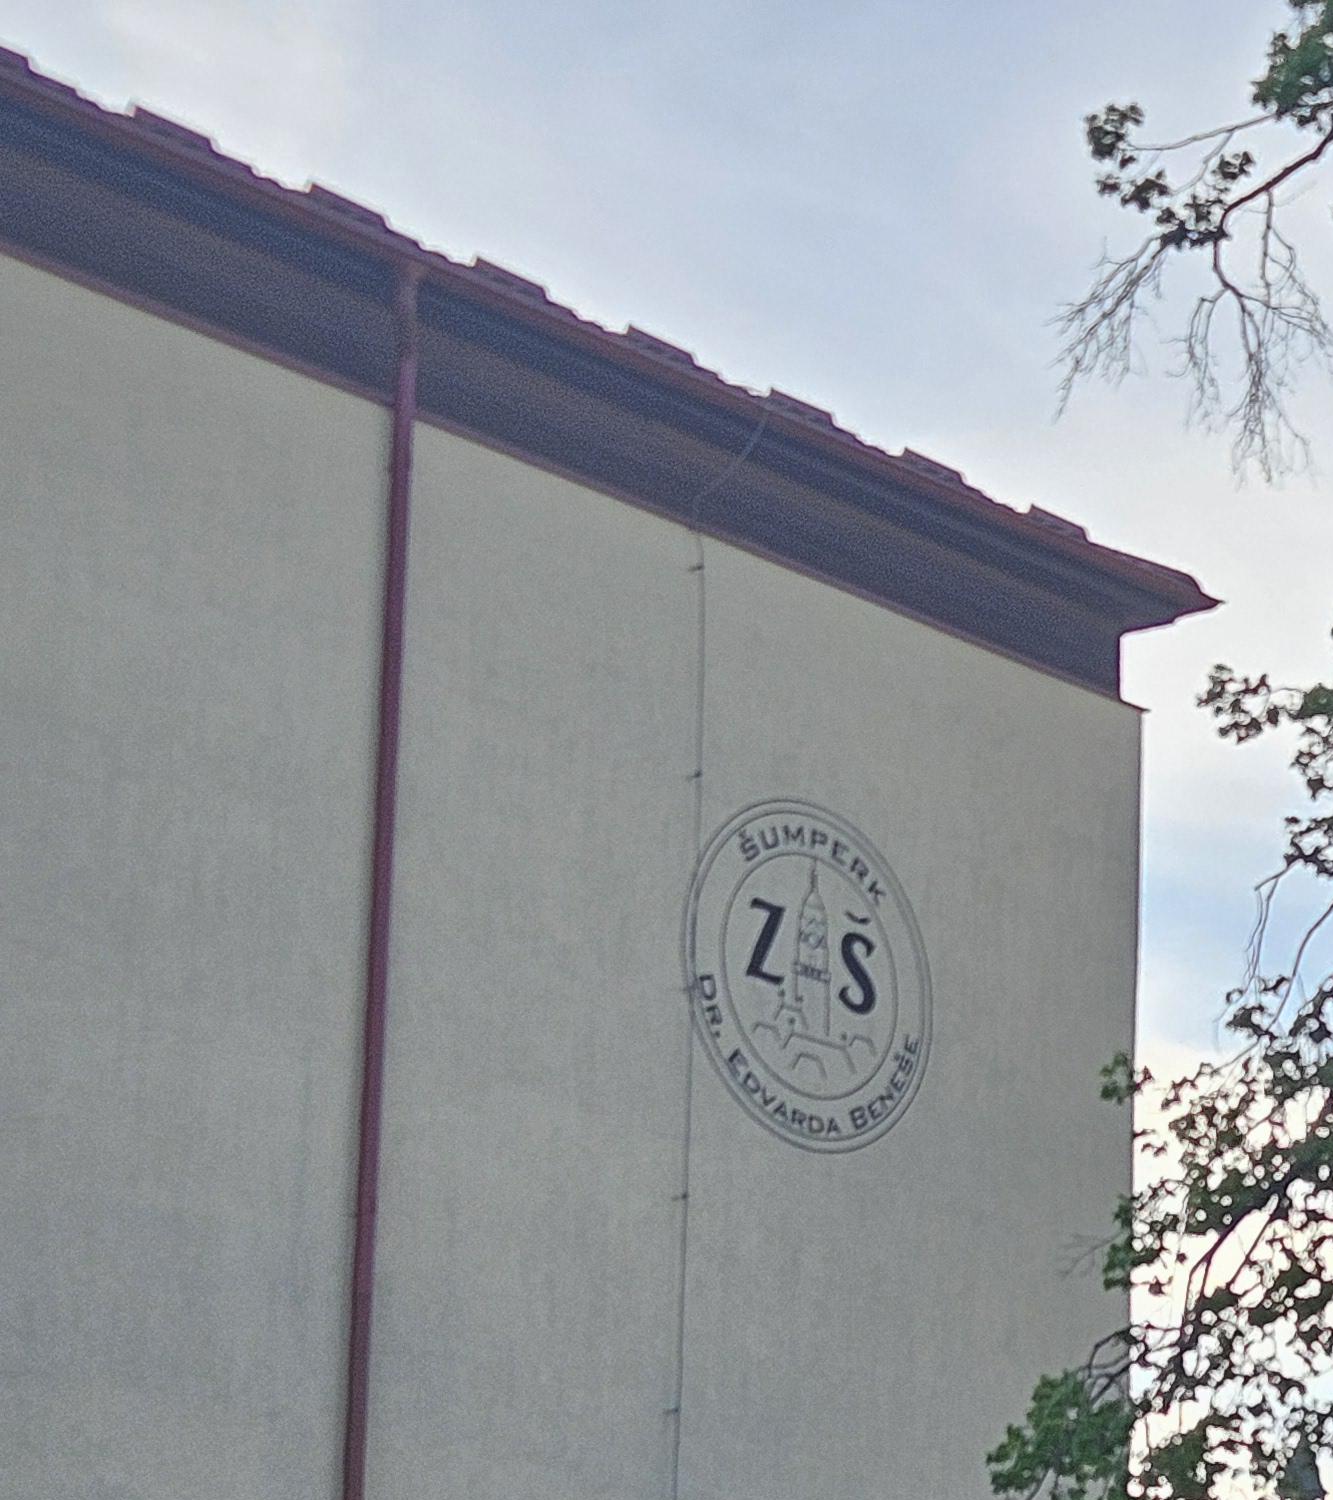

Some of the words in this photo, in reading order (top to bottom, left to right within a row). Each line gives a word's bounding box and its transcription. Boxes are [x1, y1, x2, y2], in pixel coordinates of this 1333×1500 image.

[738, 824, 886, 906] ŠUMPERK
[699, 973, 723, 1039] DR.
[727, 1048, 841, 1137] EDVARDA
[849, 1034, 920, 1131] BENEŠE
